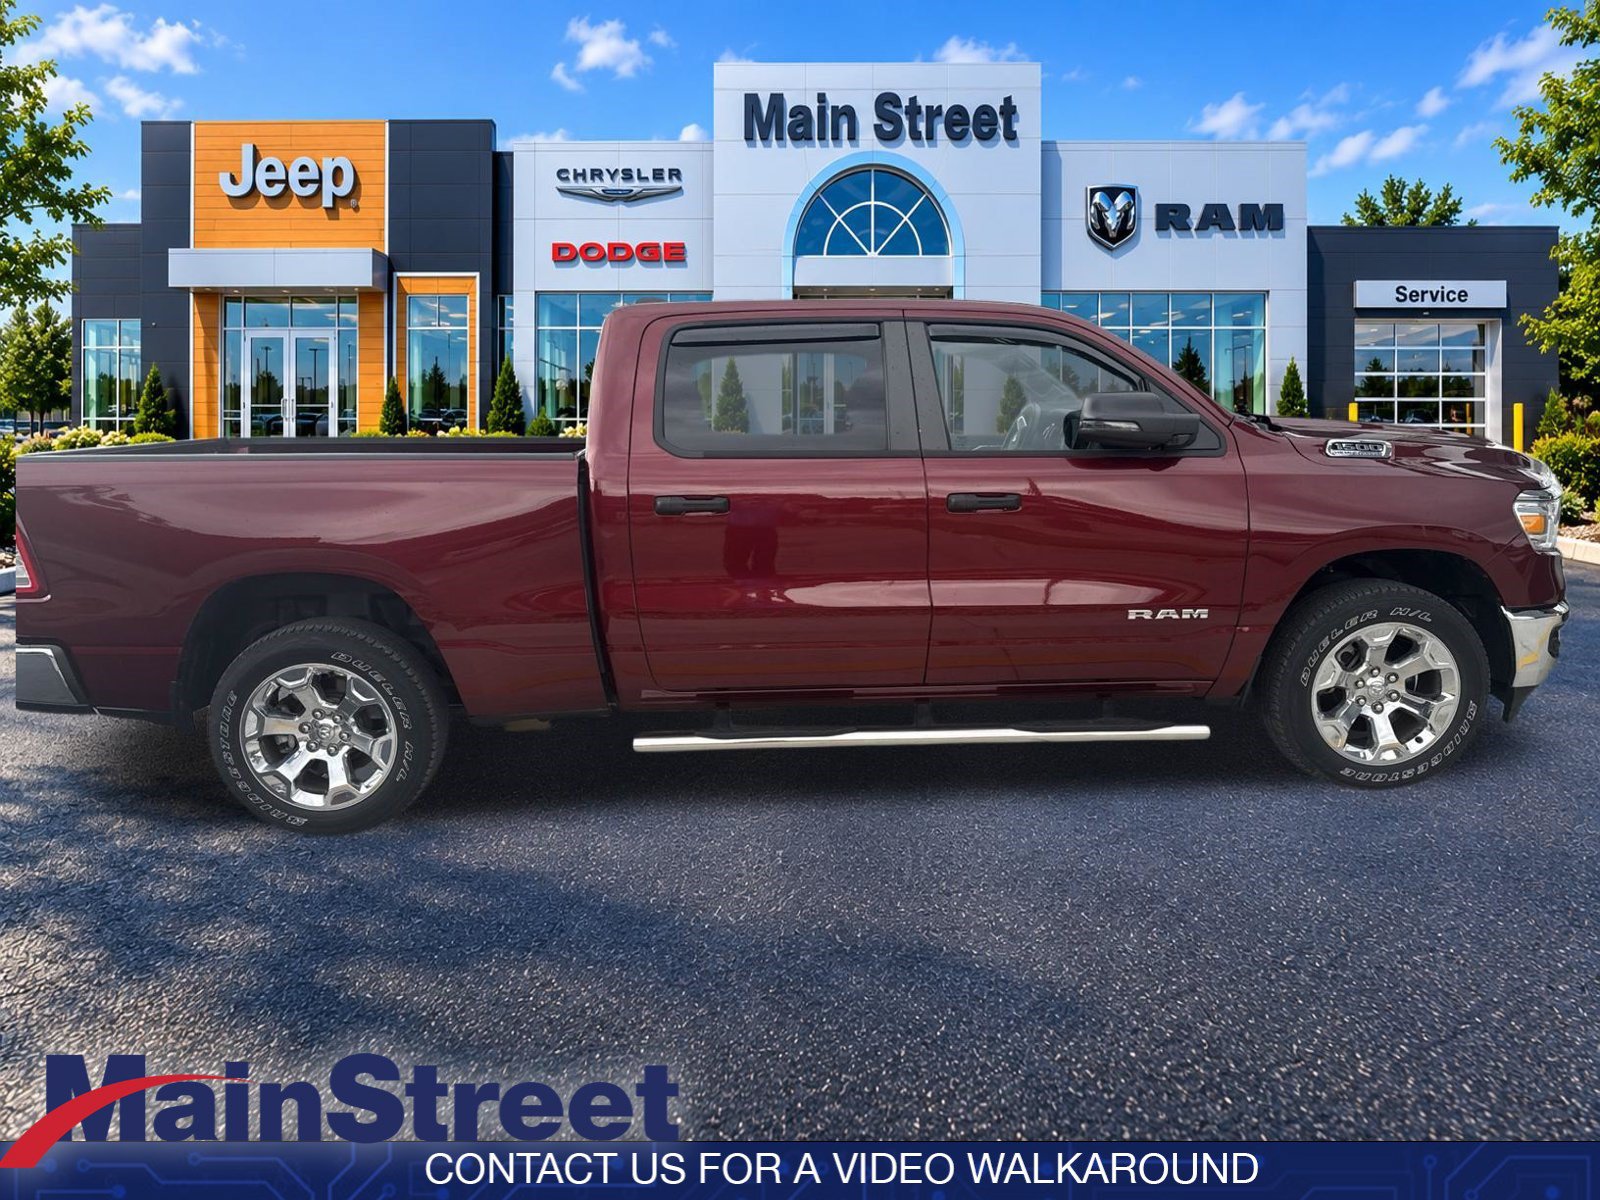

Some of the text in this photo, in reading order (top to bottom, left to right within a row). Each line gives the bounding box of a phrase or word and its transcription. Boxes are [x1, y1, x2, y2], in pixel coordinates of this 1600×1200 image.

[743, 91, 1018, 141] Main Street
[218, 143, 355, 208] Jeep
[556, 168, 682, 181] CHRYSLER
[1155, 203, 1284, 231] RAM
[551, 242, 686, 262] DODGE
[1395, 285, 1468, 303] Service
[1127, 608, 1209, 620] RAM
[1301, 607, 1432, 687] DUELER H/L
[330, 652, 413, 730] DUELER
[219, 690, 308, 827] BRIDGESTONE
[1340, 700, 1478, 783] BRIDGESTONE
